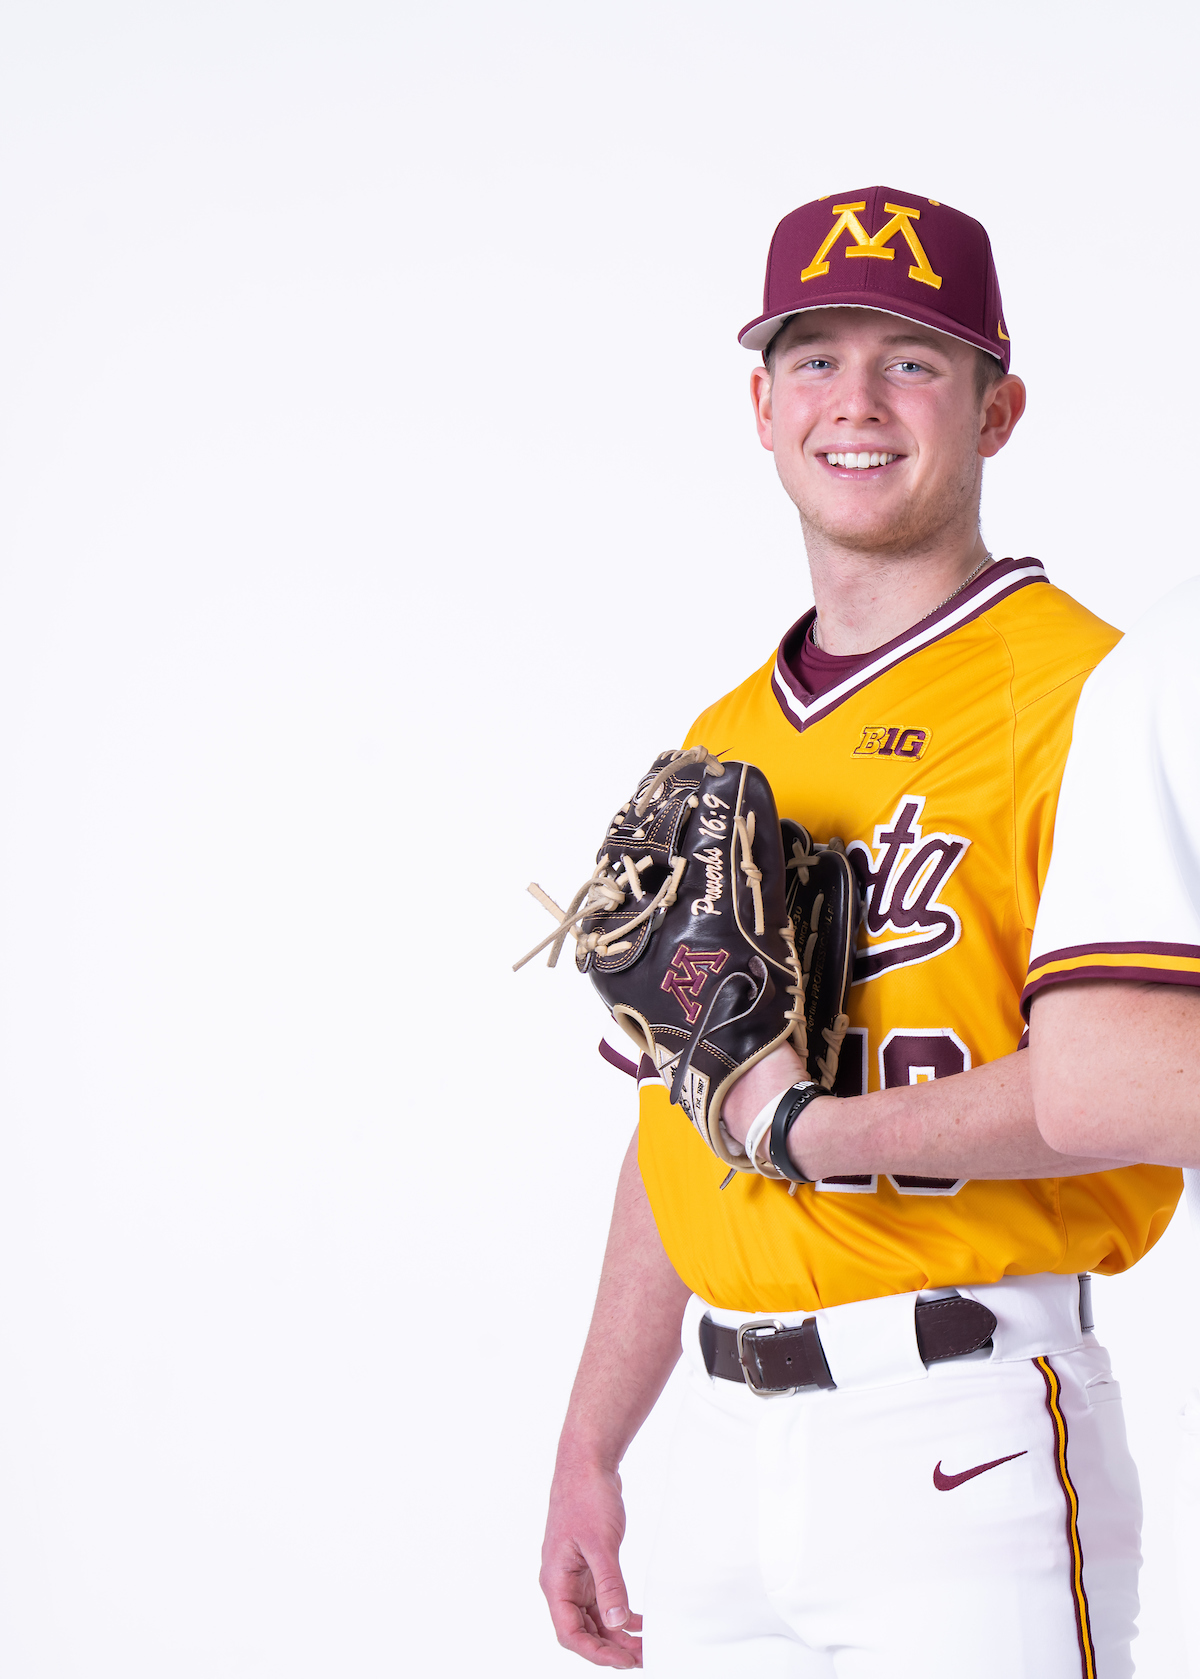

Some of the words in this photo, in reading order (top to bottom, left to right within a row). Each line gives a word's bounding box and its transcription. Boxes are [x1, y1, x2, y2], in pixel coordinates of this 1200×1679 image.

[800, 200, 943, 290] M
[698, 793, 731, 841] 16:9
[690, 846, 725, 916] Proverbs
[660, 943, 731, 1025] M
